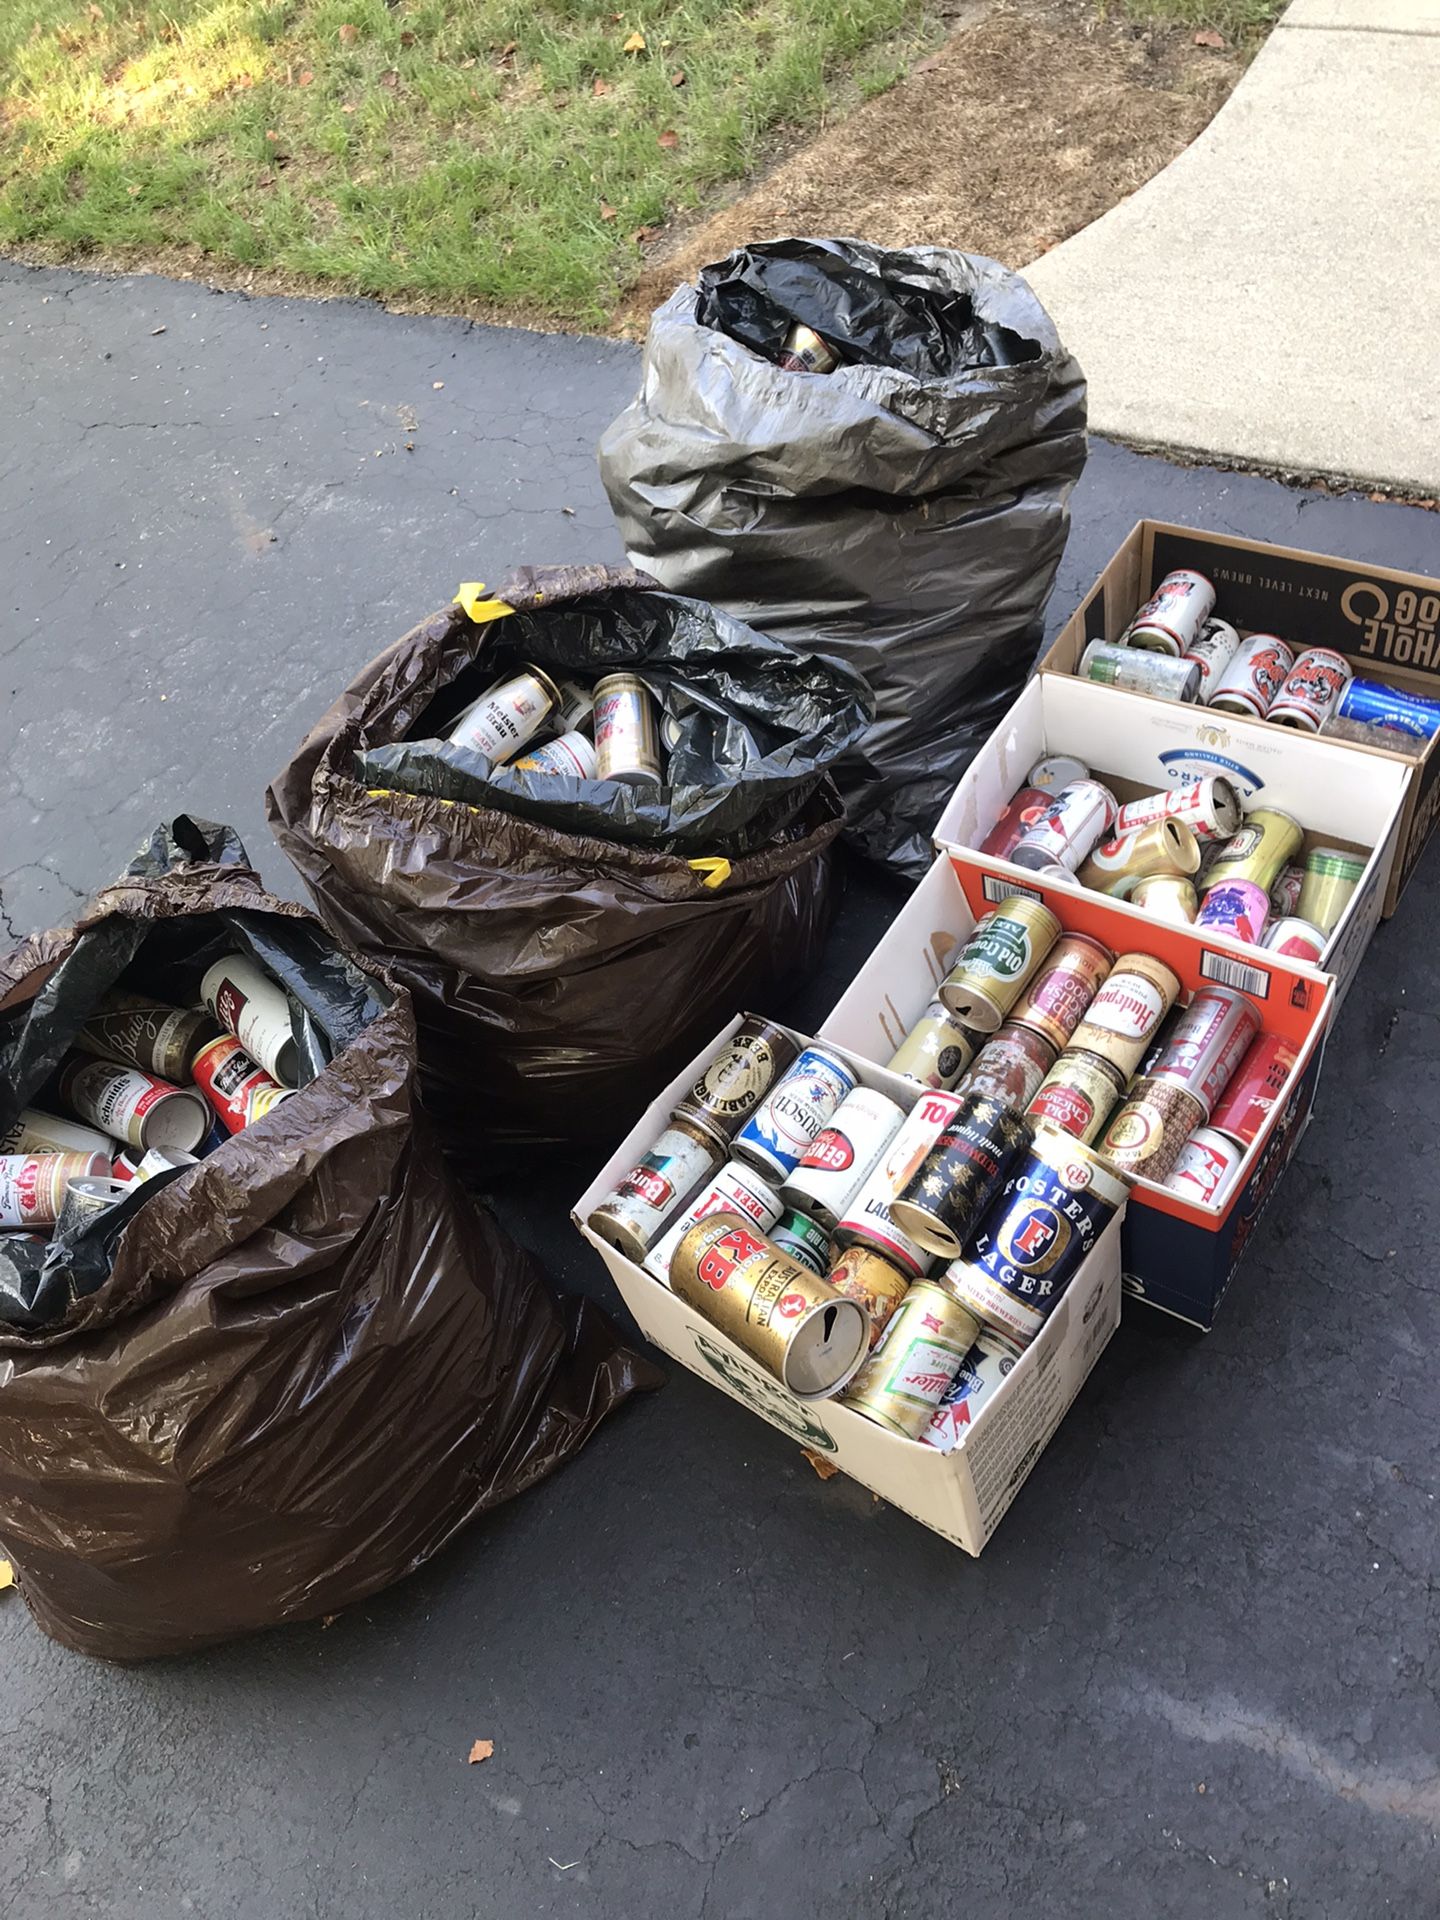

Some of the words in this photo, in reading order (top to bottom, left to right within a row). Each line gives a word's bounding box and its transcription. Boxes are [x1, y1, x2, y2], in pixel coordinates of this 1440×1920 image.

[1211, 567, 1252, 584] BREWS
[1258, 576, 1293, 592] LEVEL
[1298, 586, 1328, 601] NEXT
[1393, 589, 1440, 625] OG
[485, 713, 509, 738] Bräu
[487, 702, 520, 738] Meister
[994, 919, 1022, 935] ALE
[997, 946, 1025, 973] Old
[1043, 982, 1086, 1019] NGLISH
[1043, 996, 1077, 1030] OLDE
[107, 1010, 159, 1059] Blatz
[732, 1038, 769, 1063] BEER
[101, 1076, 131, 1125] Schmidt's
[694, 1078, 755, 1113] GABLINGE
[1038, 1093, 1089, 1124] Chicago
[1044, 1102, 1072, 1122] Old
[775, 1095, 822, 1141] BUSCH
[947, 1123, 980, 1143] liquor
[0, 1120, 26, 1156] FALS
[978, 1135, 1004, 1158] malt
[805, 1142, 847, 1169] GENE
[935, 1134, 999, 1178] BUDWEISER
[731, 1187, 764, 1218] BEER
[864, 1198, 896, 1226] LAG
[1000, 1175, 1094, 1253] FOSTER'S
[691, 1224, 732, 1259] Lager
[1013, 1216, 1054, 1258] F
[693, 1227, 770, 1293] KB
[976, 1231, 1051, 1298] LAGER
[752, 1268, 779, 1308] EXPORT
[756, 1265, 797, 1327] AUSTRALIAN
[985, 1299, 1024, 1327] BREWERIES
[957, 1368, 984, 1393] Blue
